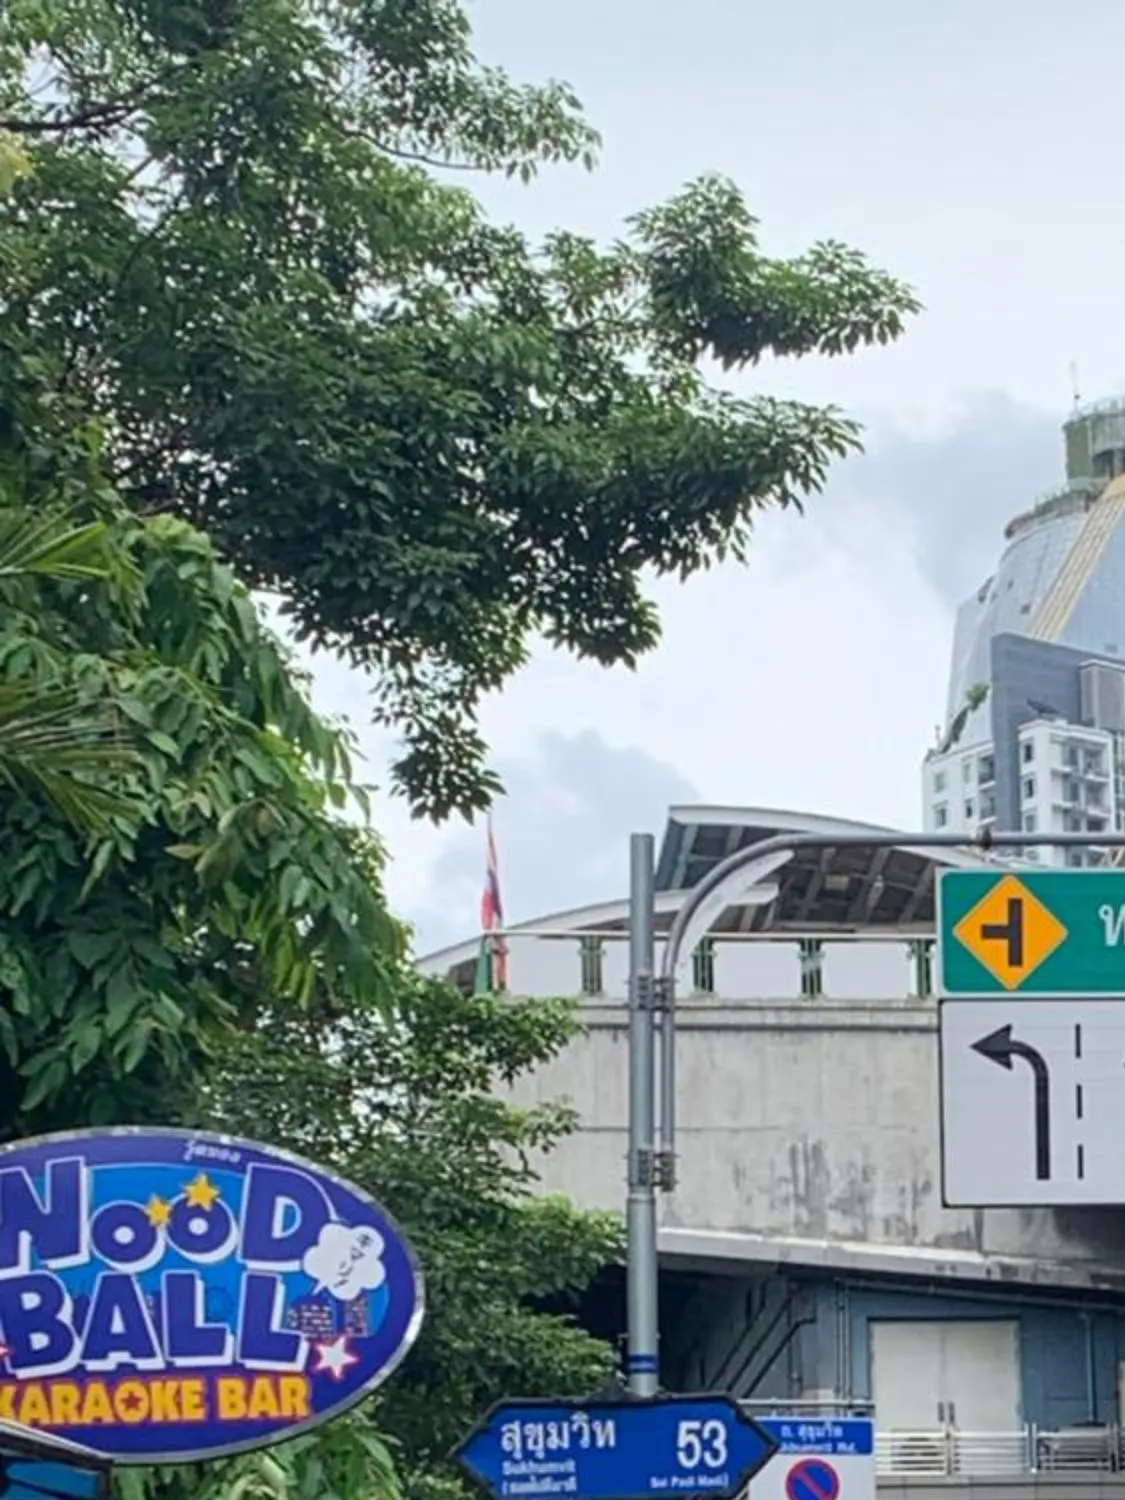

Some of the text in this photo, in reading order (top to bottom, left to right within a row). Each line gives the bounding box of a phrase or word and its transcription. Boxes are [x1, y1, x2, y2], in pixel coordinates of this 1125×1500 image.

[3, 1269, 310, 1379] BALL
[217, 1376, 310, 1421] BAR
[501, 1411, 728, 1469] สุขุมวิท 53
